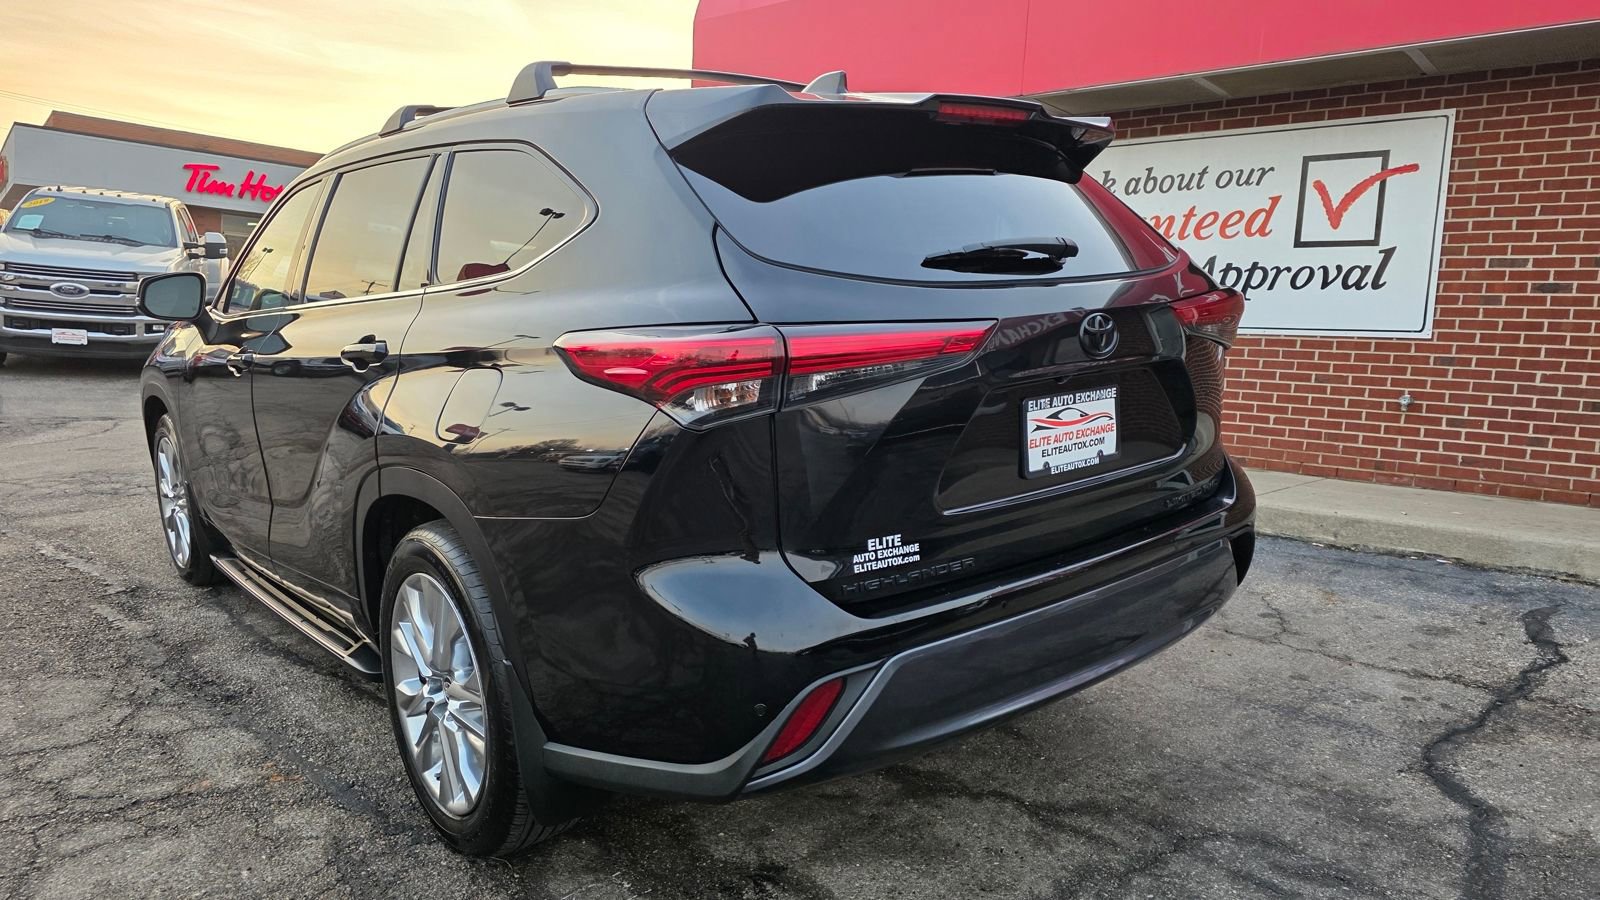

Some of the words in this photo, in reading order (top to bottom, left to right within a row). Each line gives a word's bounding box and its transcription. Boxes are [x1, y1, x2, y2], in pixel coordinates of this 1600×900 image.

[182, 163, 235, 198] Tim
[1124, 166, 1209, 196] about
[1215, 166, 1275, 188] our
[1144, 195, 1282, 241] nteed
[1028, 398, 1051, 412] ELITE
[1052, 394, 1074, 407] AUTO
[1075, 387, 1117, 403] EXCHANGE
[1029, 436, 1052, 449] ELITE
[1052, 431, 1074, 445] AUTO
[1076, 423, 1115, 441] EXCHANGE
[1042, 437, 1105, 457] ELITEAUTOX.COM
[1051, 457, 1100, 475] ELITEAUTOX.COM
[853, 551, 876, 563] AUTO
[877, 543, 920, 559] EXCHANGE
[867, 534, 902, 551] ELITE
[841, 557, 975, 594] HIGHLANDER
[853, 554, 920, 574] ELITEAUTOX.com
